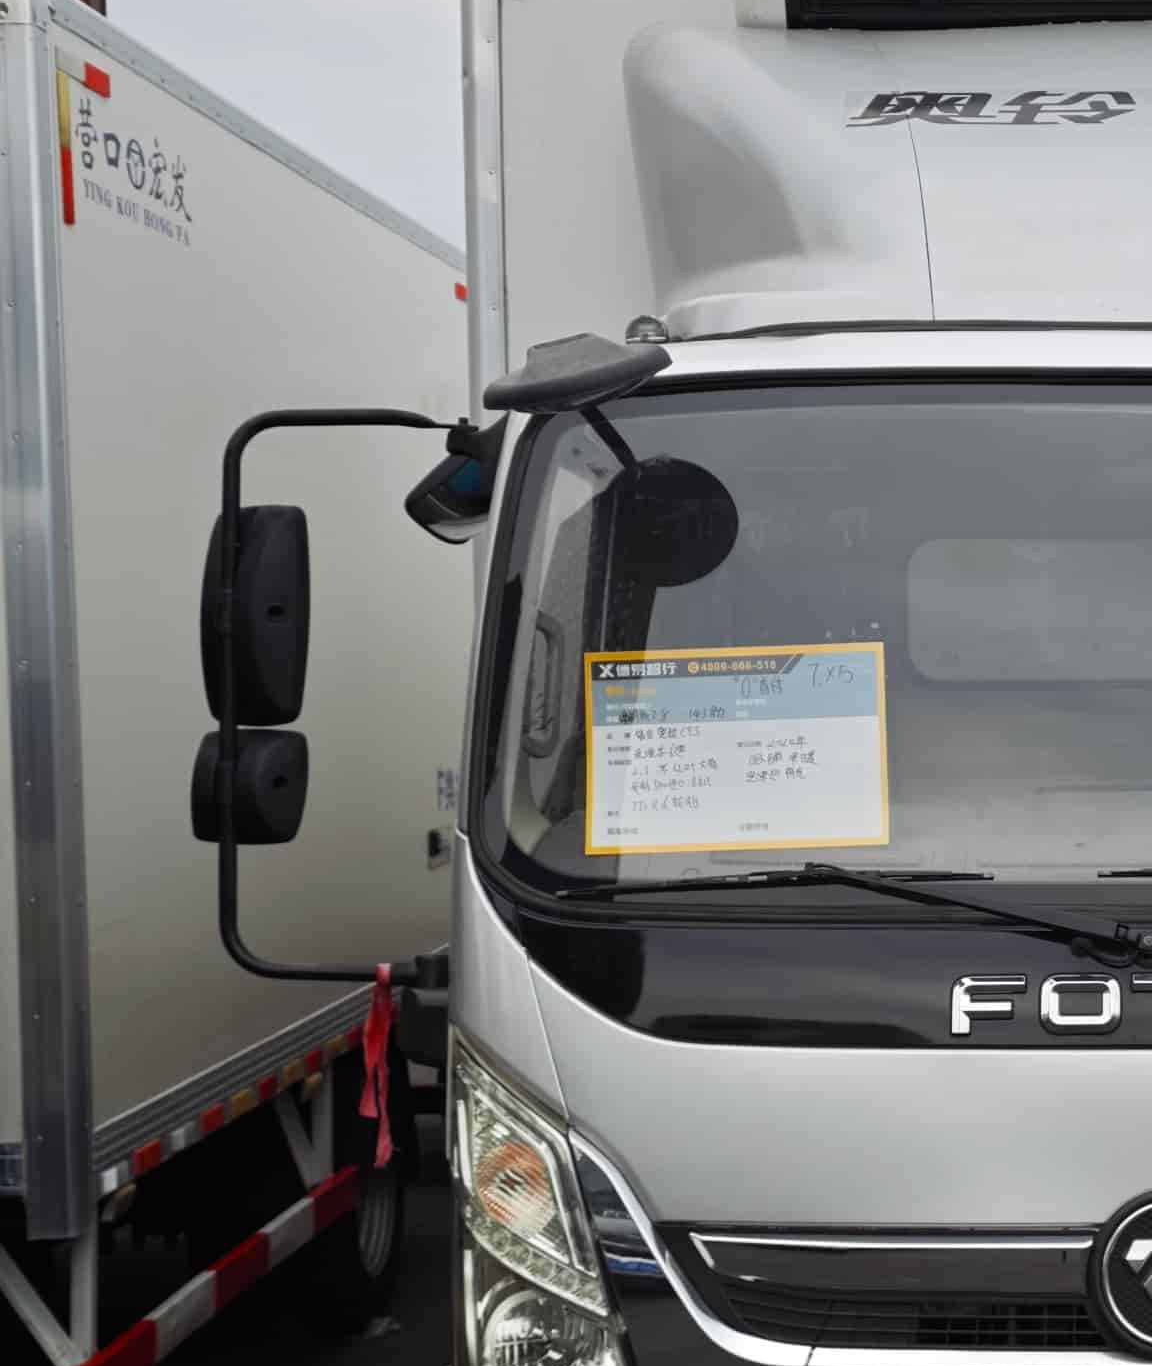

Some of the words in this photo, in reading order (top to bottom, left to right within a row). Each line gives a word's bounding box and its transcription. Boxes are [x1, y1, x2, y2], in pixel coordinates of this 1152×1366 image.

[846, 90, 1136, 127] 奥铃
[83, 178, 112, 209] YING
[116, 196, 141, 223] KOU
[144, 209, 174, 239] HONG
